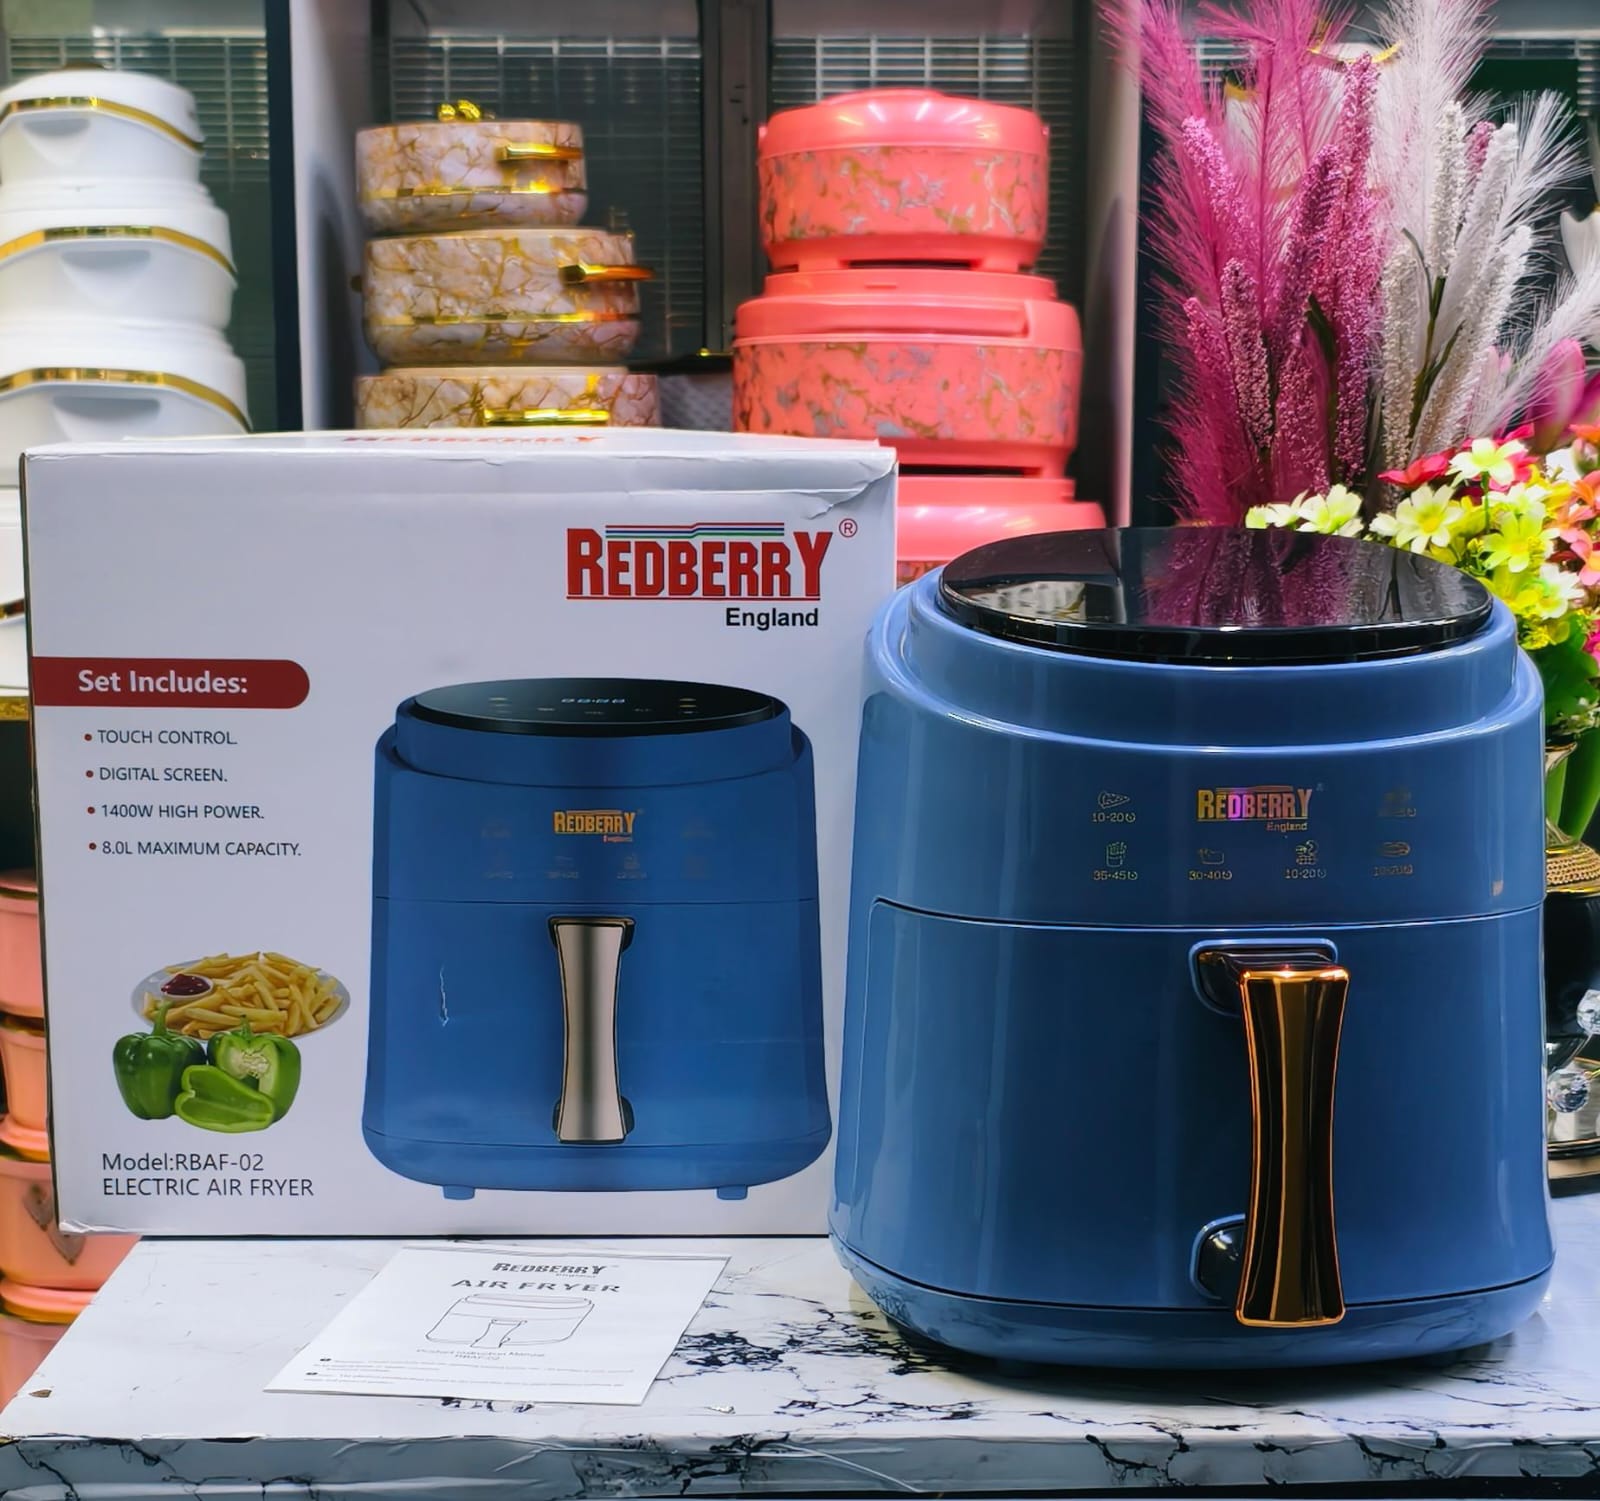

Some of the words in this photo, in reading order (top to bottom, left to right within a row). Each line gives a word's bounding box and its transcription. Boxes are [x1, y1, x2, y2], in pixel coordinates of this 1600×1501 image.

[566, 527, 834, 598] REDBERRY
[725, 607, 819, 631] England
[78, 669, 121, 693] Set
[129, 671, 248, 693] Includes:
[98, 729, 153, 743] TOUCH
[99, 767, 159, 781] DIGITAL
[164, 768, 228, 782] SCREEN.
[1197, 788, 1312, 819] REDBERRY
[101, 804, 153, 819] 1400W
[158, 805, 199, 819] HIGH
[203, 805, 265, 820] POWER.
[1092, 812, 1124, 823] 10-20
[553, 811, 635, 833] REDBERRY
[1266, 822, 1308, 832] England
[102, 841, 133, 855] 8.0L
[137, 841, 221, 857] MAXIMUM
[225, 841, 302, 857] CAPACITY.
[1284, 868, 1316, 879] 10-20
[102, 1153, 264, 1171] Model:RBAF-02
[103, 1178, 199, 1196] ELECTRIC
[207, 1178, 242, 1196] AIR
[250, 1179, 314, 1196] FRYER
[492, 1262, 607, 1275] REDBERRY
[452, 1279, 508, 1289] AIR
[518, 1282, 620, 1292] FRYER
